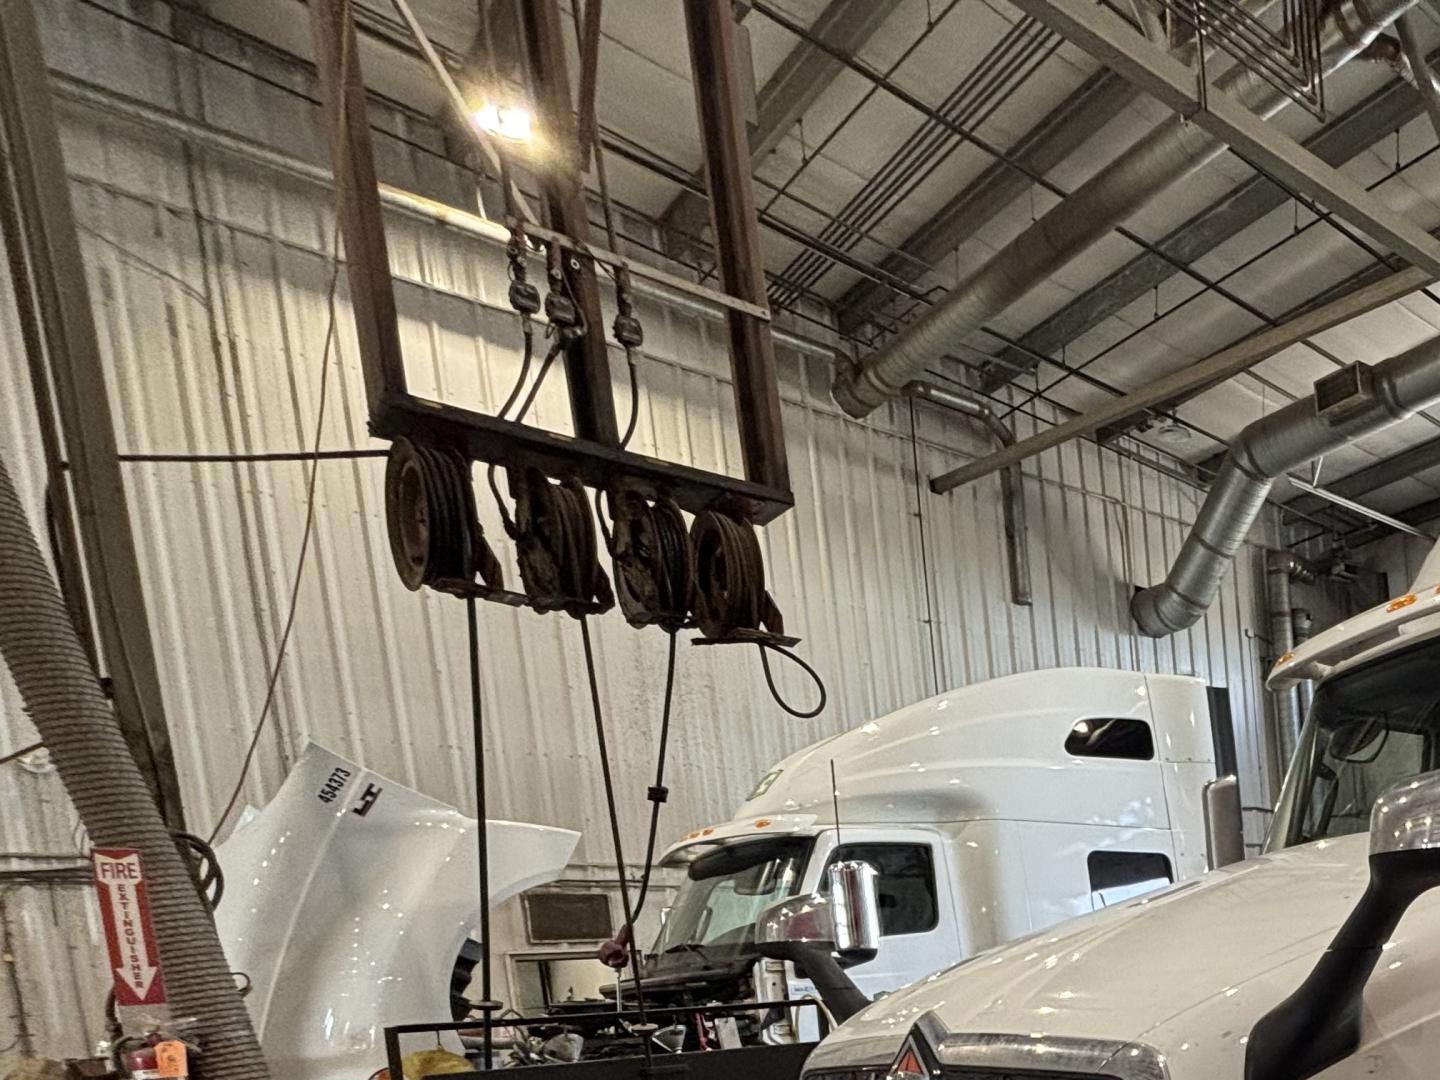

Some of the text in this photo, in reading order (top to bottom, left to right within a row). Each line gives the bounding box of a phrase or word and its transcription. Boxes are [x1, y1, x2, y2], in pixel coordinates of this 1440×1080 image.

[317, 768, 351, 803] 454373
[352, 783, 383, 817] LT
[101, 863, 138, 879] FIRE
[117, 884, 145, 988] EXTINGUISHER
